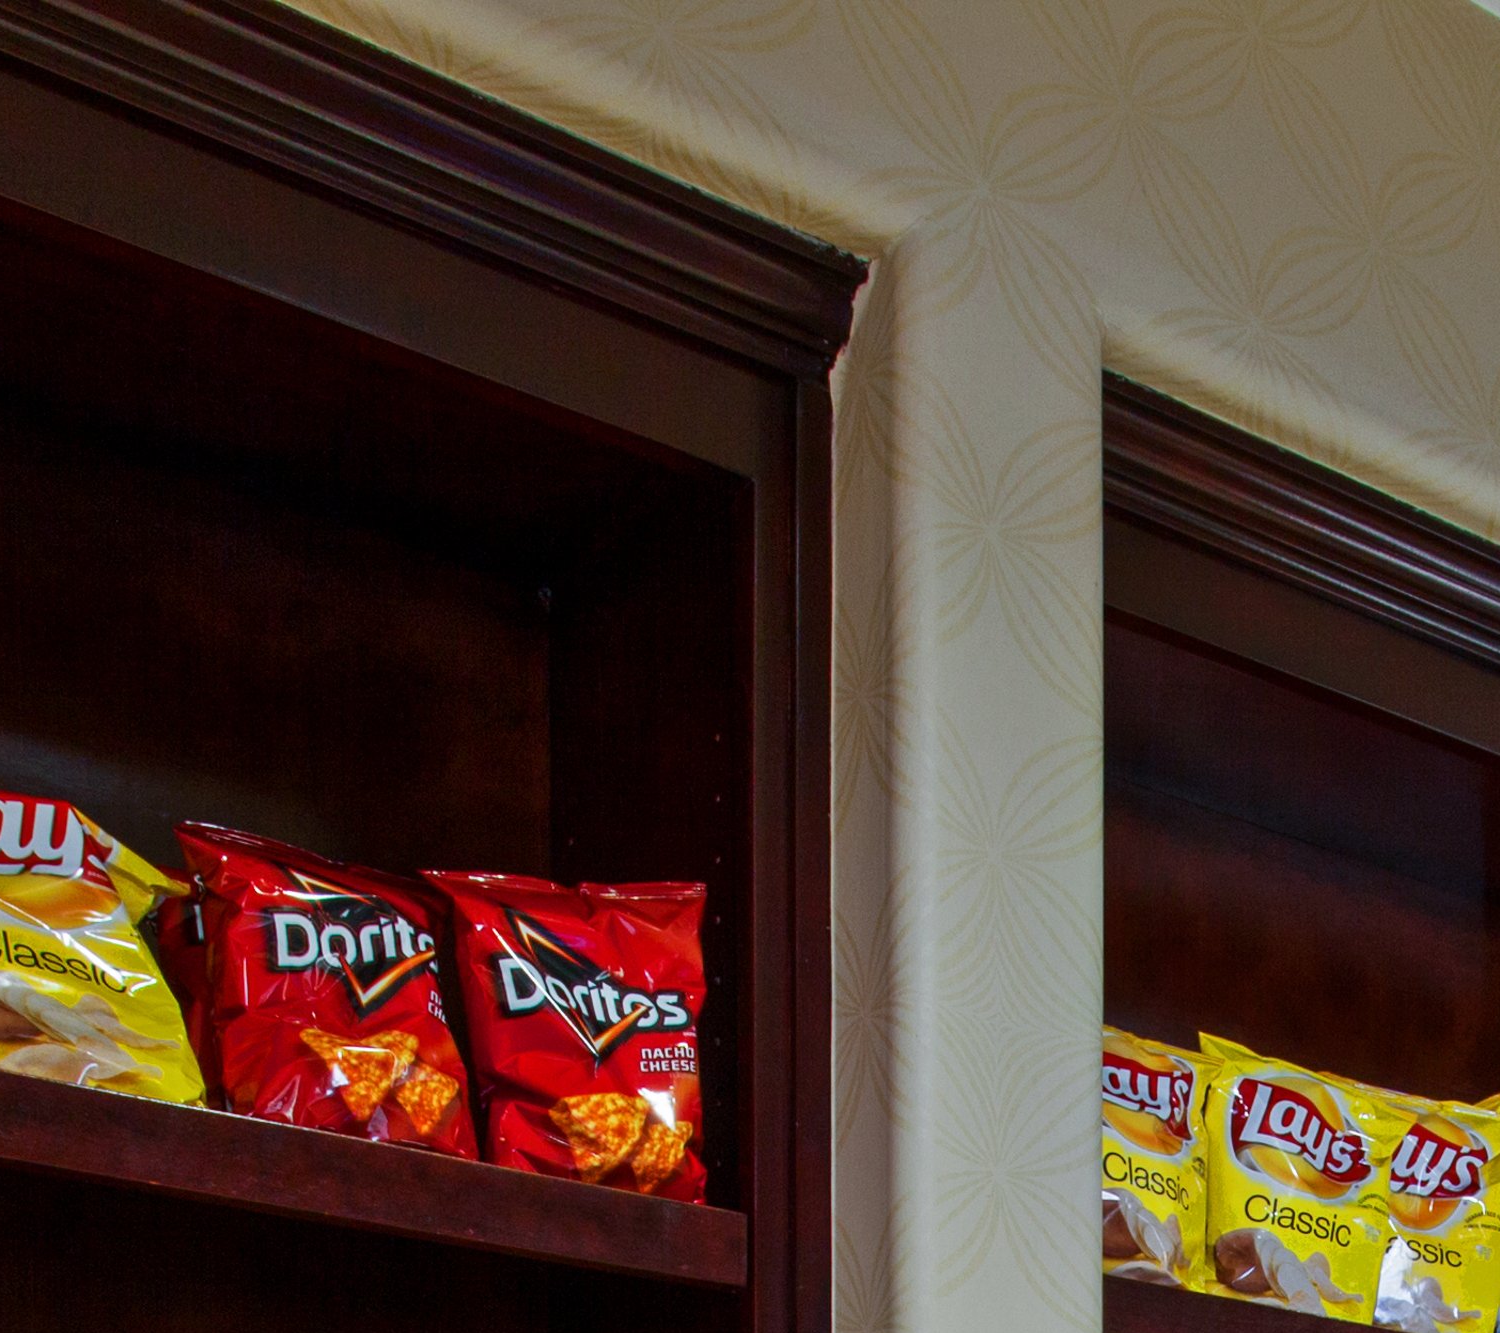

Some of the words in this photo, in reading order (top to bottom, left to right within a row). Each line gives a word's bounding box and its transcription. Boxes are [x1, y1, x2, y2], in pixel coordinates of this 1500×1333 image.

[498, 957, 689, 1030] Doritos
[638, 1058, 697, 1074] CHEESE
[640, 1043, 696, 1061] NACHO
[1239, 1082, 1361, 1175] Lay's
[1102, 1151, 1190, 1211] Classic
[1244, 1194, 1352, 1248] Classic
